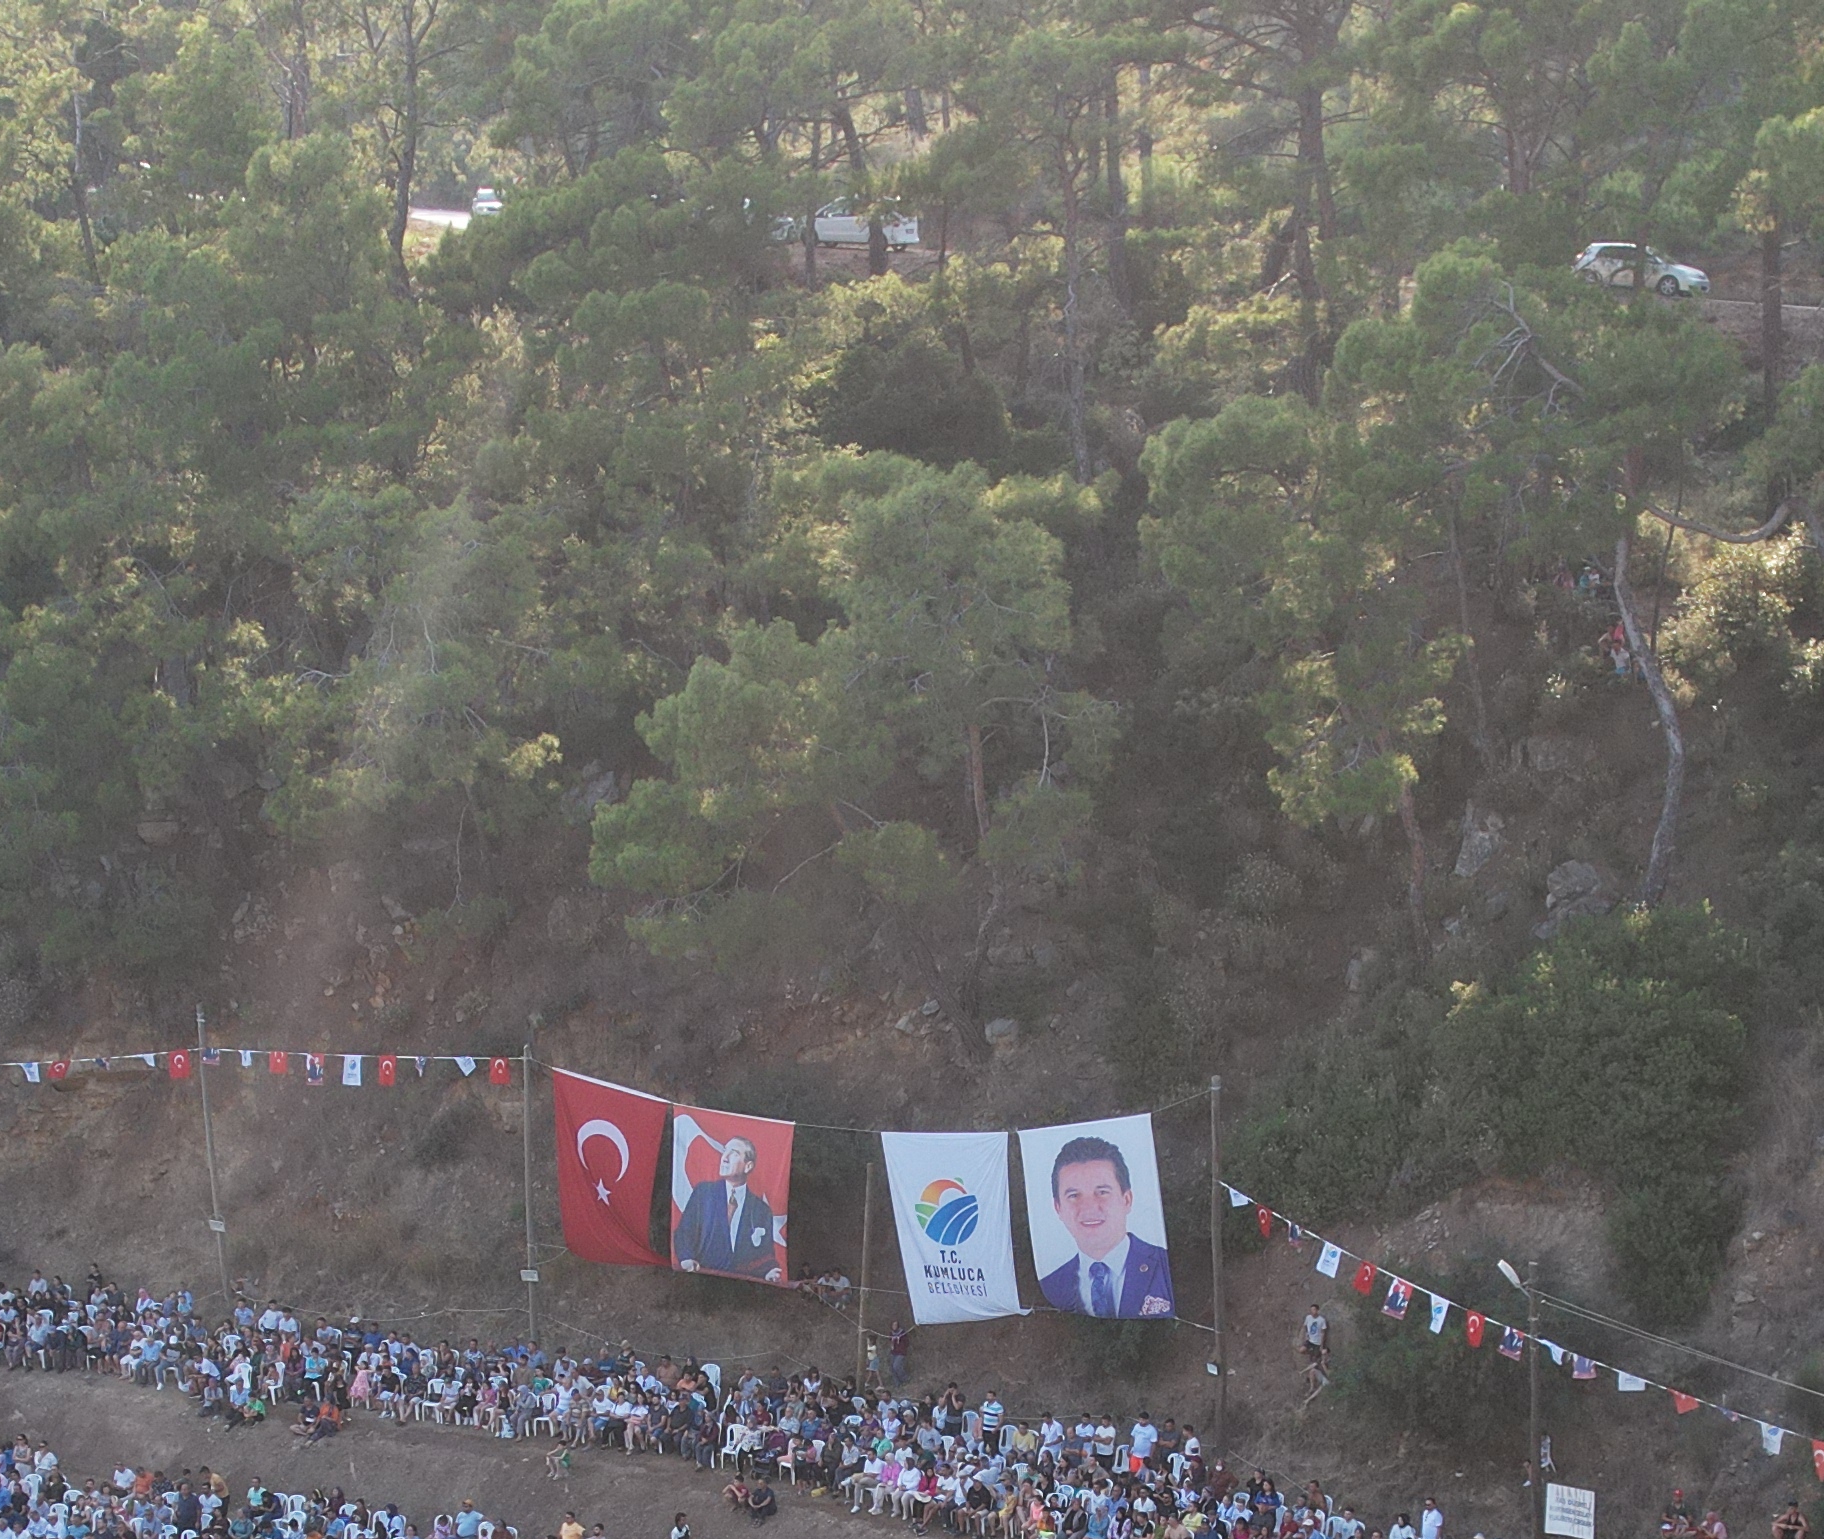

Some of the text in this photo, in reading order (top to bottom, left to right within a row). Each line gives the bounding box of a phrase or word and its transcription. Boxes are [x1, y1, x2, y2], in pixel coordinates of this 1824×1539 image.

[940, 1250, 962, 1264] T.C.
[924, 1264, 985, 1281] KUMLUCA
[927, 1281, 988, 1297] BELEDİYESİ
